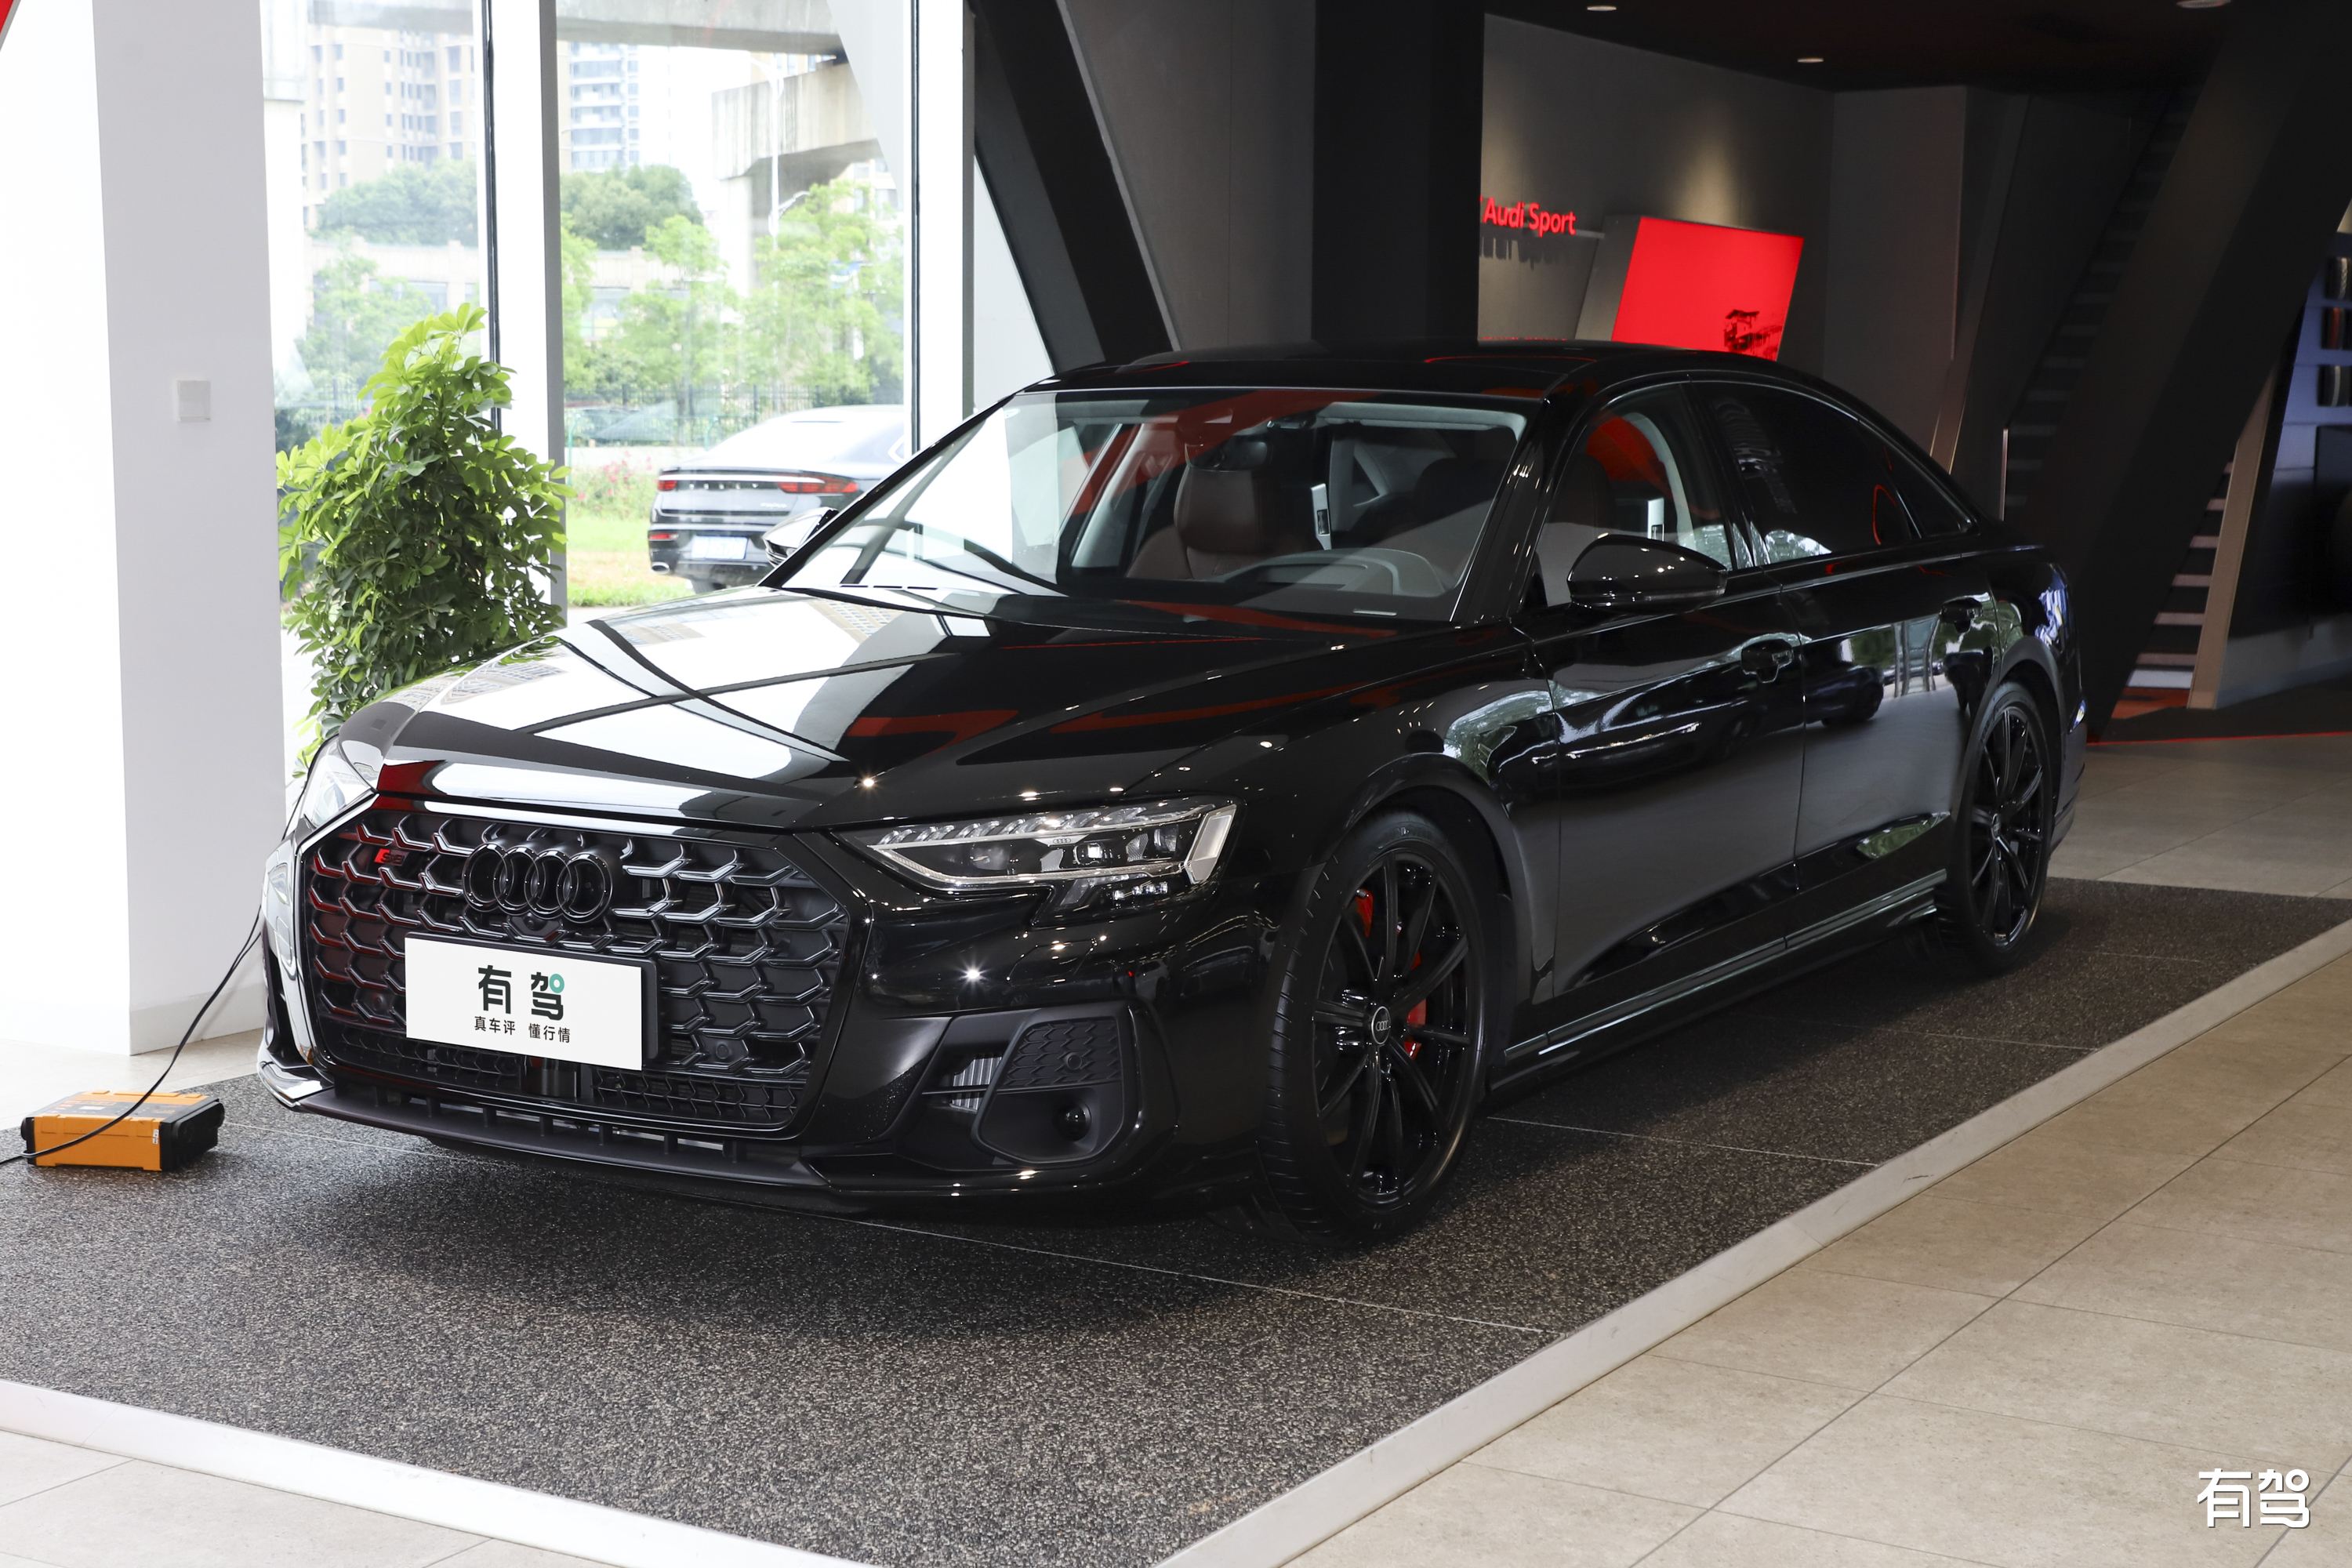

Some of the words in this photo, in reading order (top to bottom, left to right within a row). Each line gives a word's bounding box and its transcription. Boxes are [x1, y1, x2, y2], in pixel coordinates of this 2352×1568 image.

[1483, 197, 1525, 228] Audi
[1528, 202, 1576, 238] Sport
[477, 964, 565, 1021] 有驾
[474, 1016, 516, 1035] 真车评
[528, 1022, 571, 1044] 懂行情
